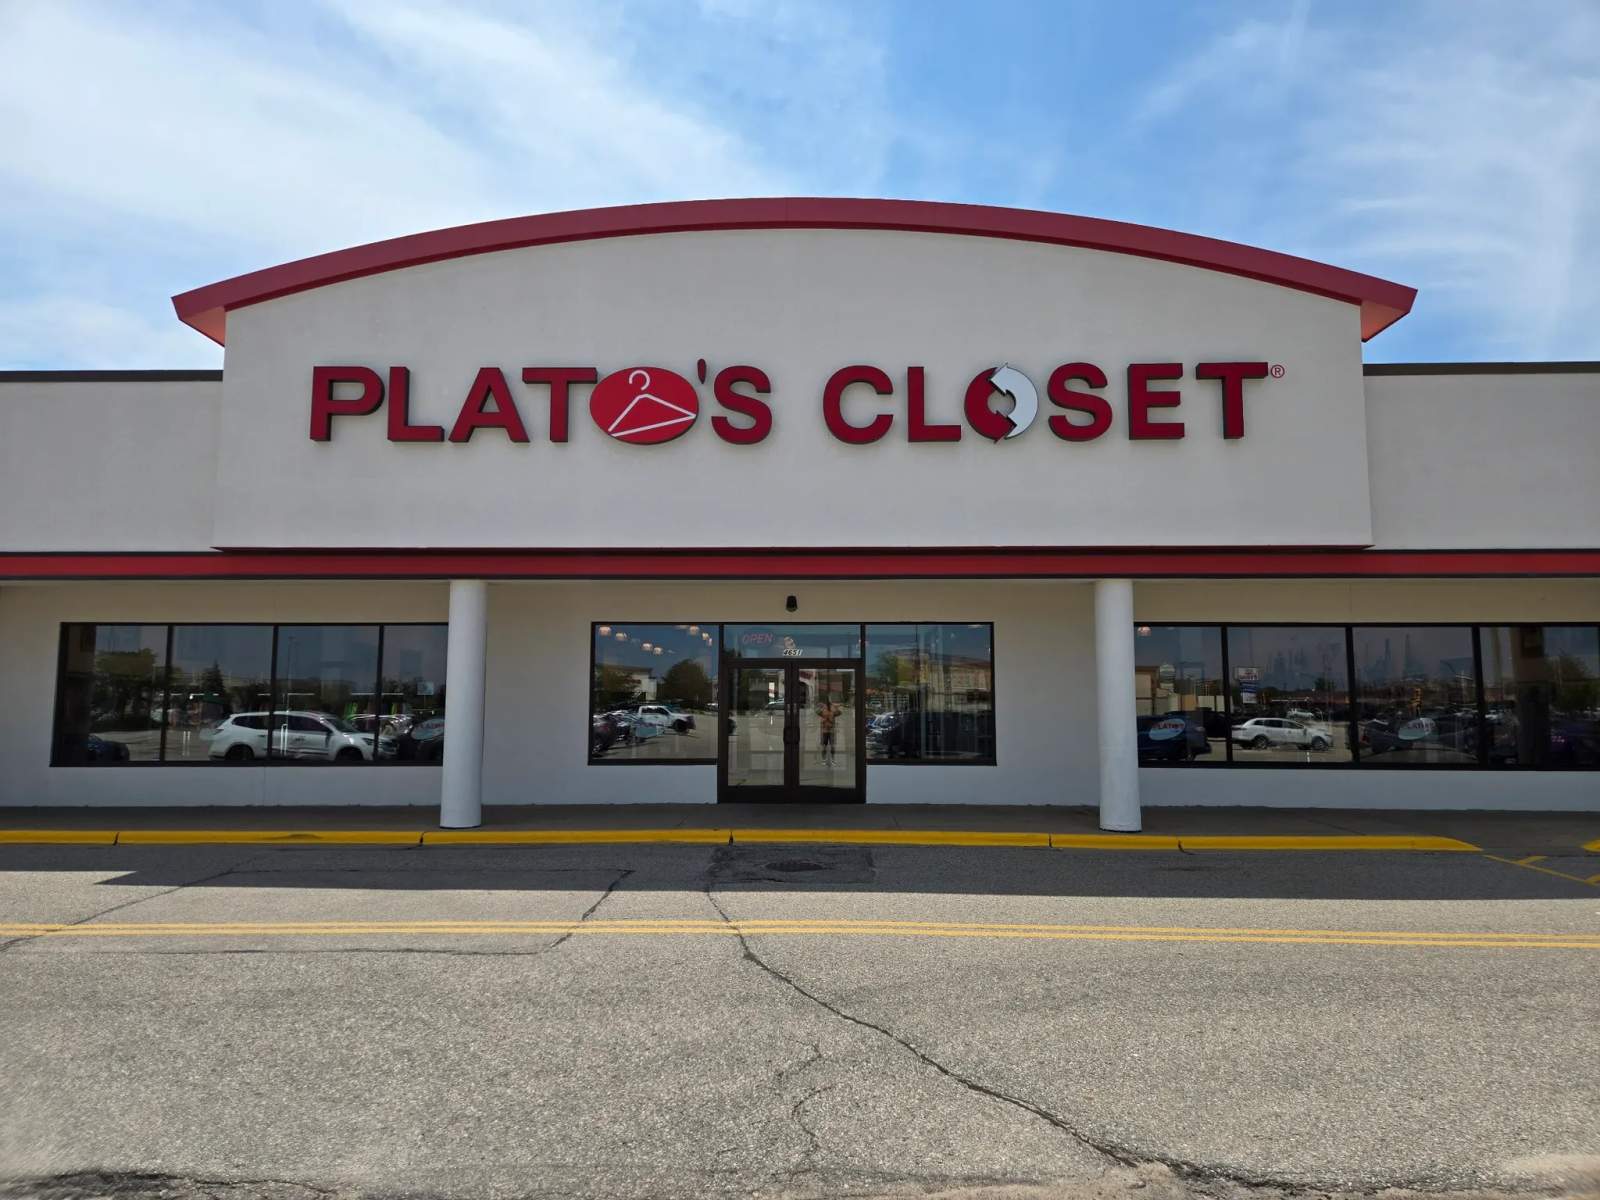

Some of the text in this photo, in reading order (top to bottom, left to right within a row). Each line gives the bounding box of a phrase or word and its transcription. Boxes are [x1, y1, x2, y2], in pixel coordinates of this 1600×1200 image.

[310, 358, 773, 445] PLATO'S
[742, 632, 774, 645] OPEN
[783, 648, 803, 657] 4651
